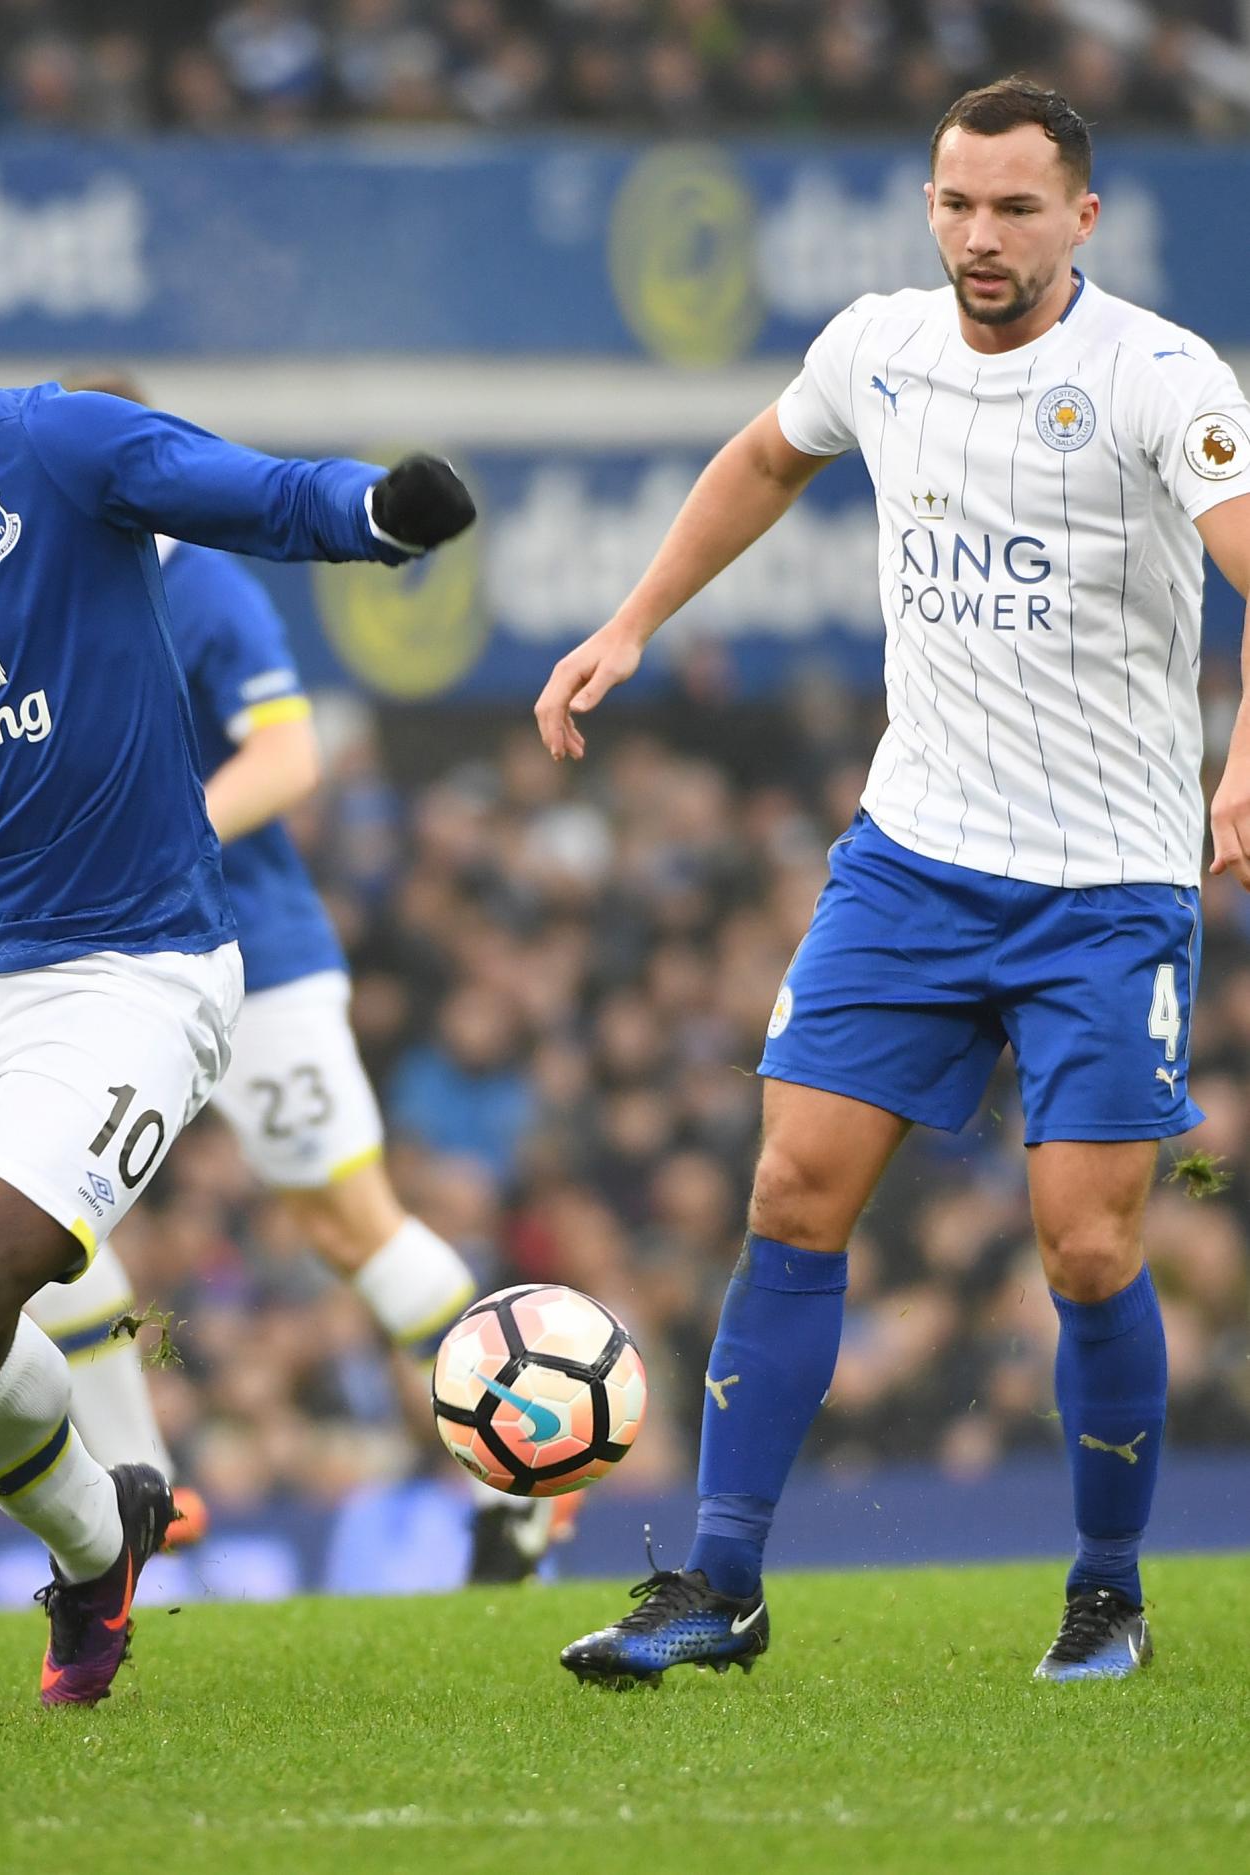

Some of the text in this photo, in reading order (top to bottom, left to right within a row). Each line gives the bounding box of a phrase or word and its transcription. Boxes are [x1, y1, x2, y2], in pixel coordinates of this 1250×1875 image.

[899, 528, 1052, 585] KING
[899, 584, 1053, 631] POWER
[1147, 963, 1182, 1062] 4
[246, 1063, 337, 1139] 23
[87, 1083, 165, 1190] 10
[77, 1186, 104, 1218] umbro
